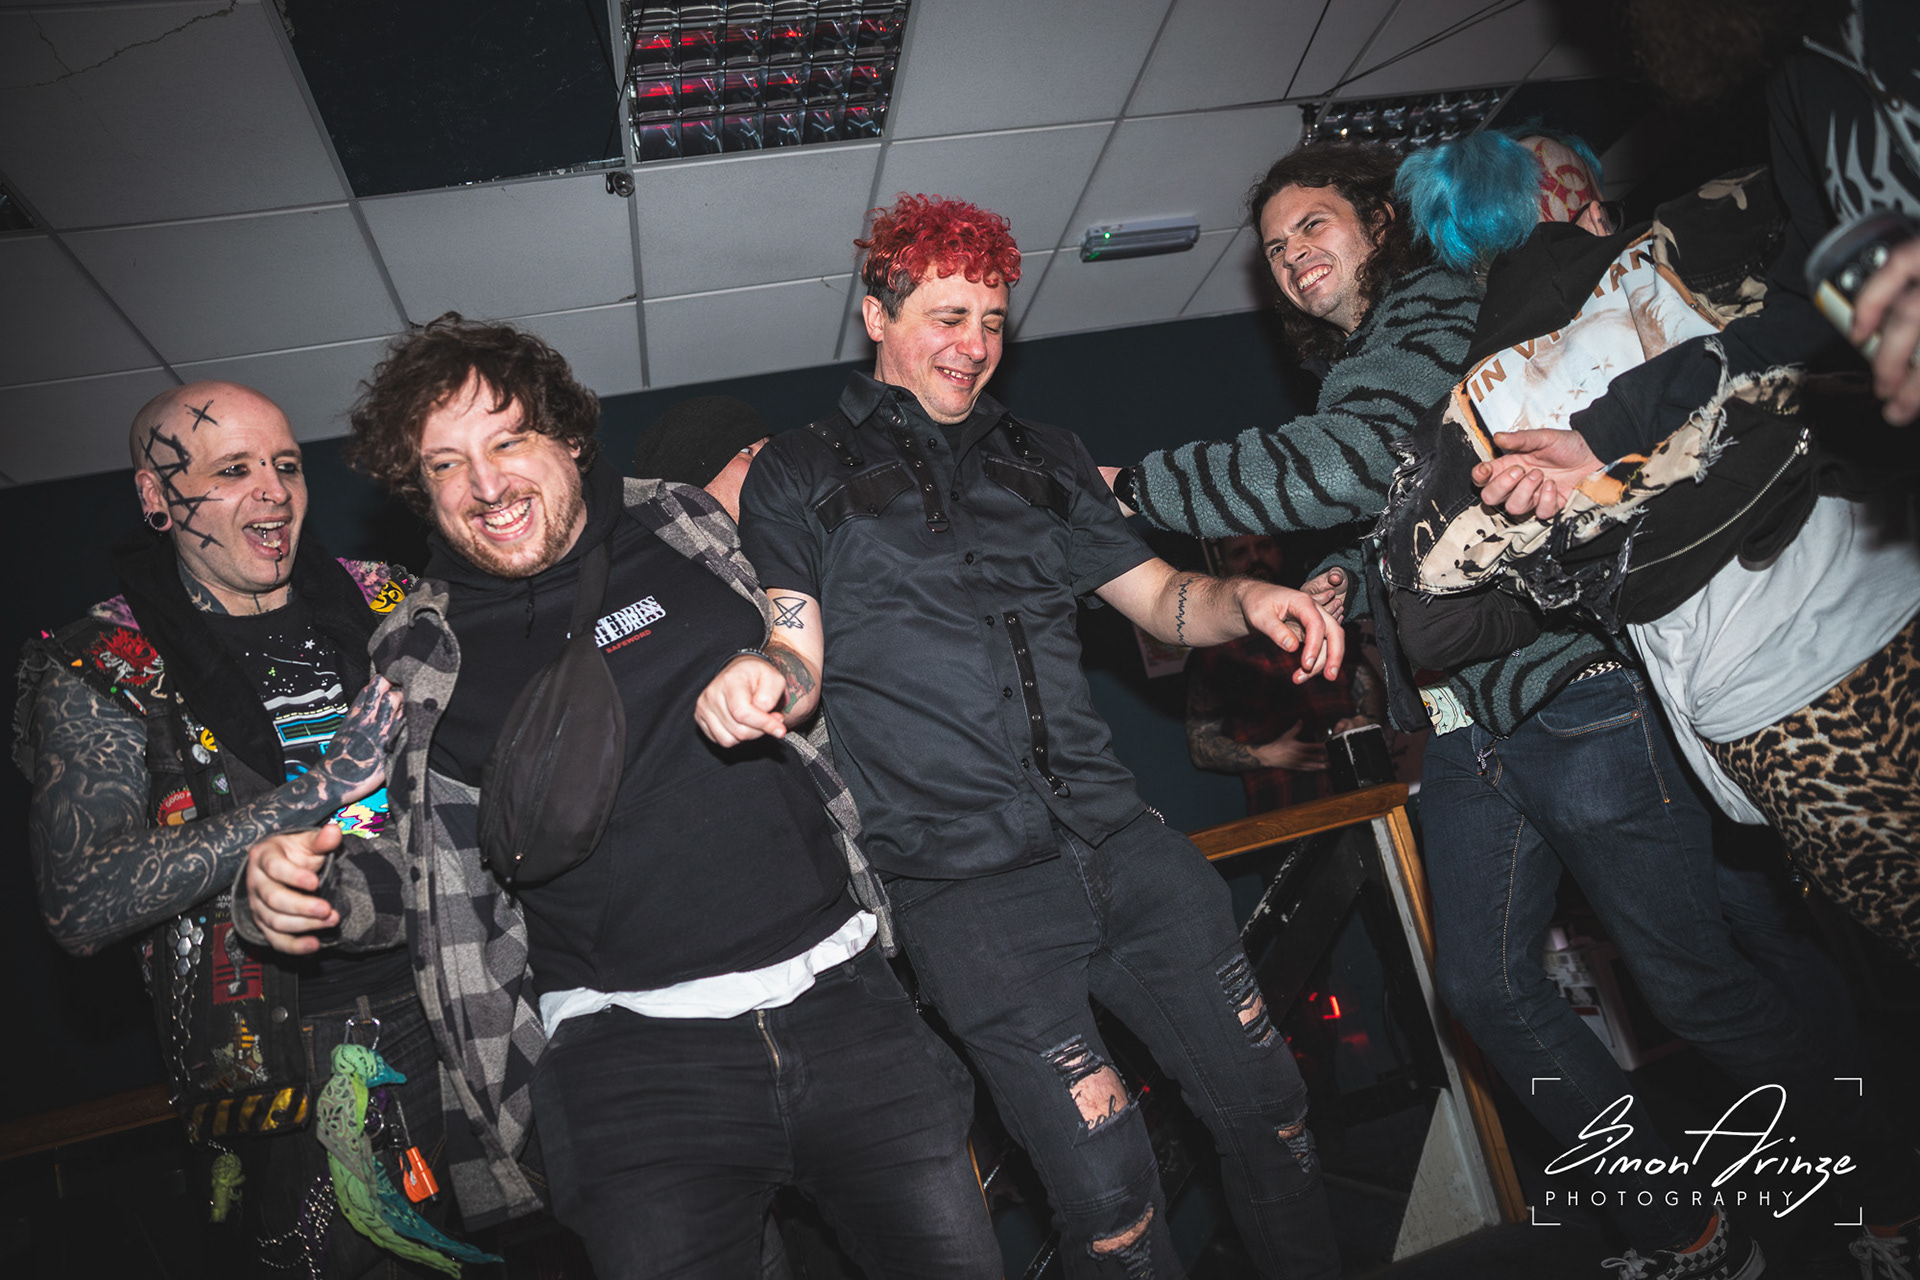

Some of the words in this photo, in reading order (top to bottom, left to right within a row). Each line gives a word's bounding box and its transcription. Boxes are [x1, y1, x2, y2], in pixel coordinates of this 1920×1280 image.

[1470, 358, 1507, 403] IN
[605, 629, 652, 654] SAFEWORD
[165, 792, 186, 808] GOOD
